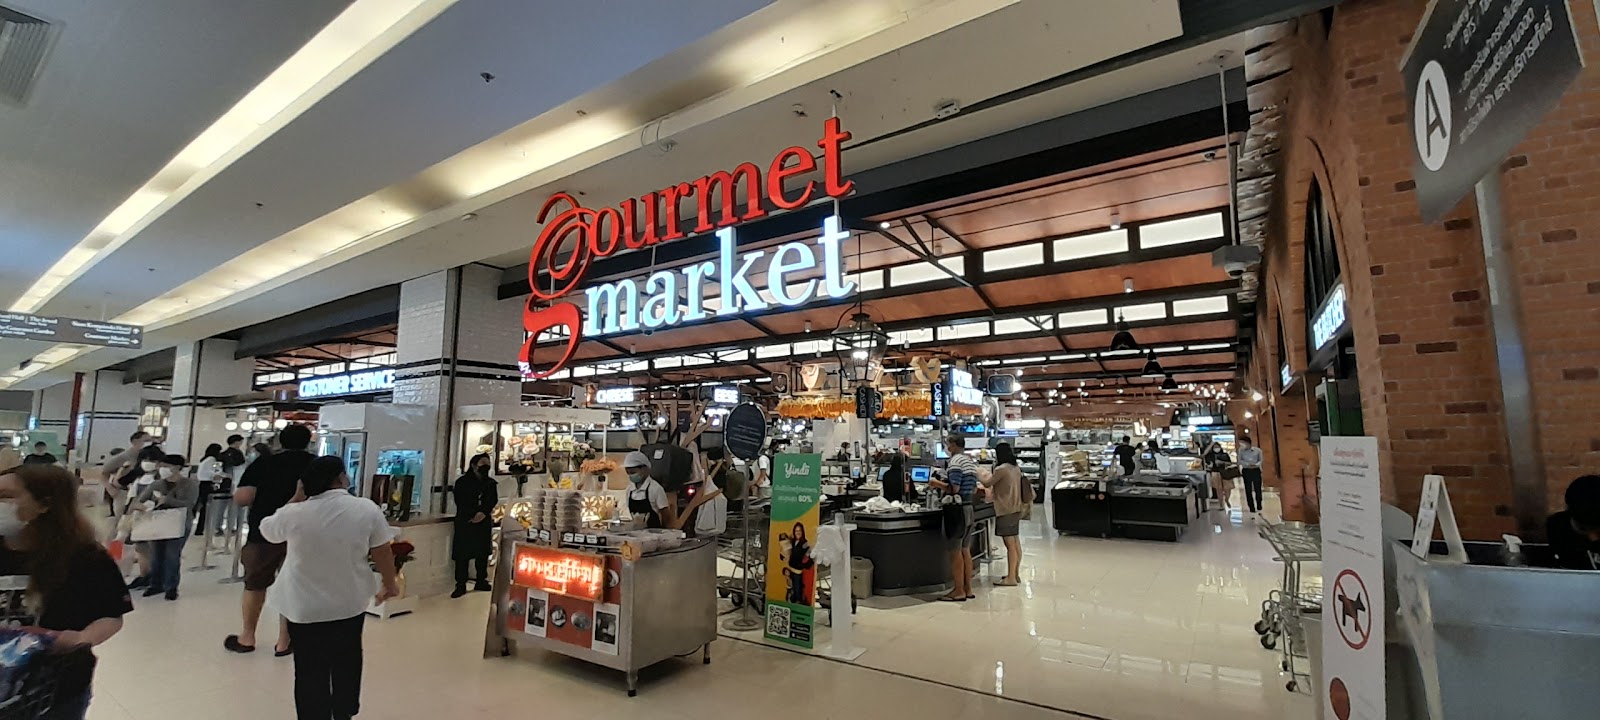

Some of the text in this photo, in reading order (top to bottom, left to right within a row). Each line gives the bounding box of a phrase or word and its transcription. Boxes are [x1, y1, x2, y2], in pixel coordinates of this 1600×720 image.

[1425, 78, 1447, 158] A
[517, 117, 854, 378] gourmet
[584, 215, 857, 337] market
[299, 369, 396, 397] CUSTOMER SERVICE
[934, 383, 943, 416] CASHIER
